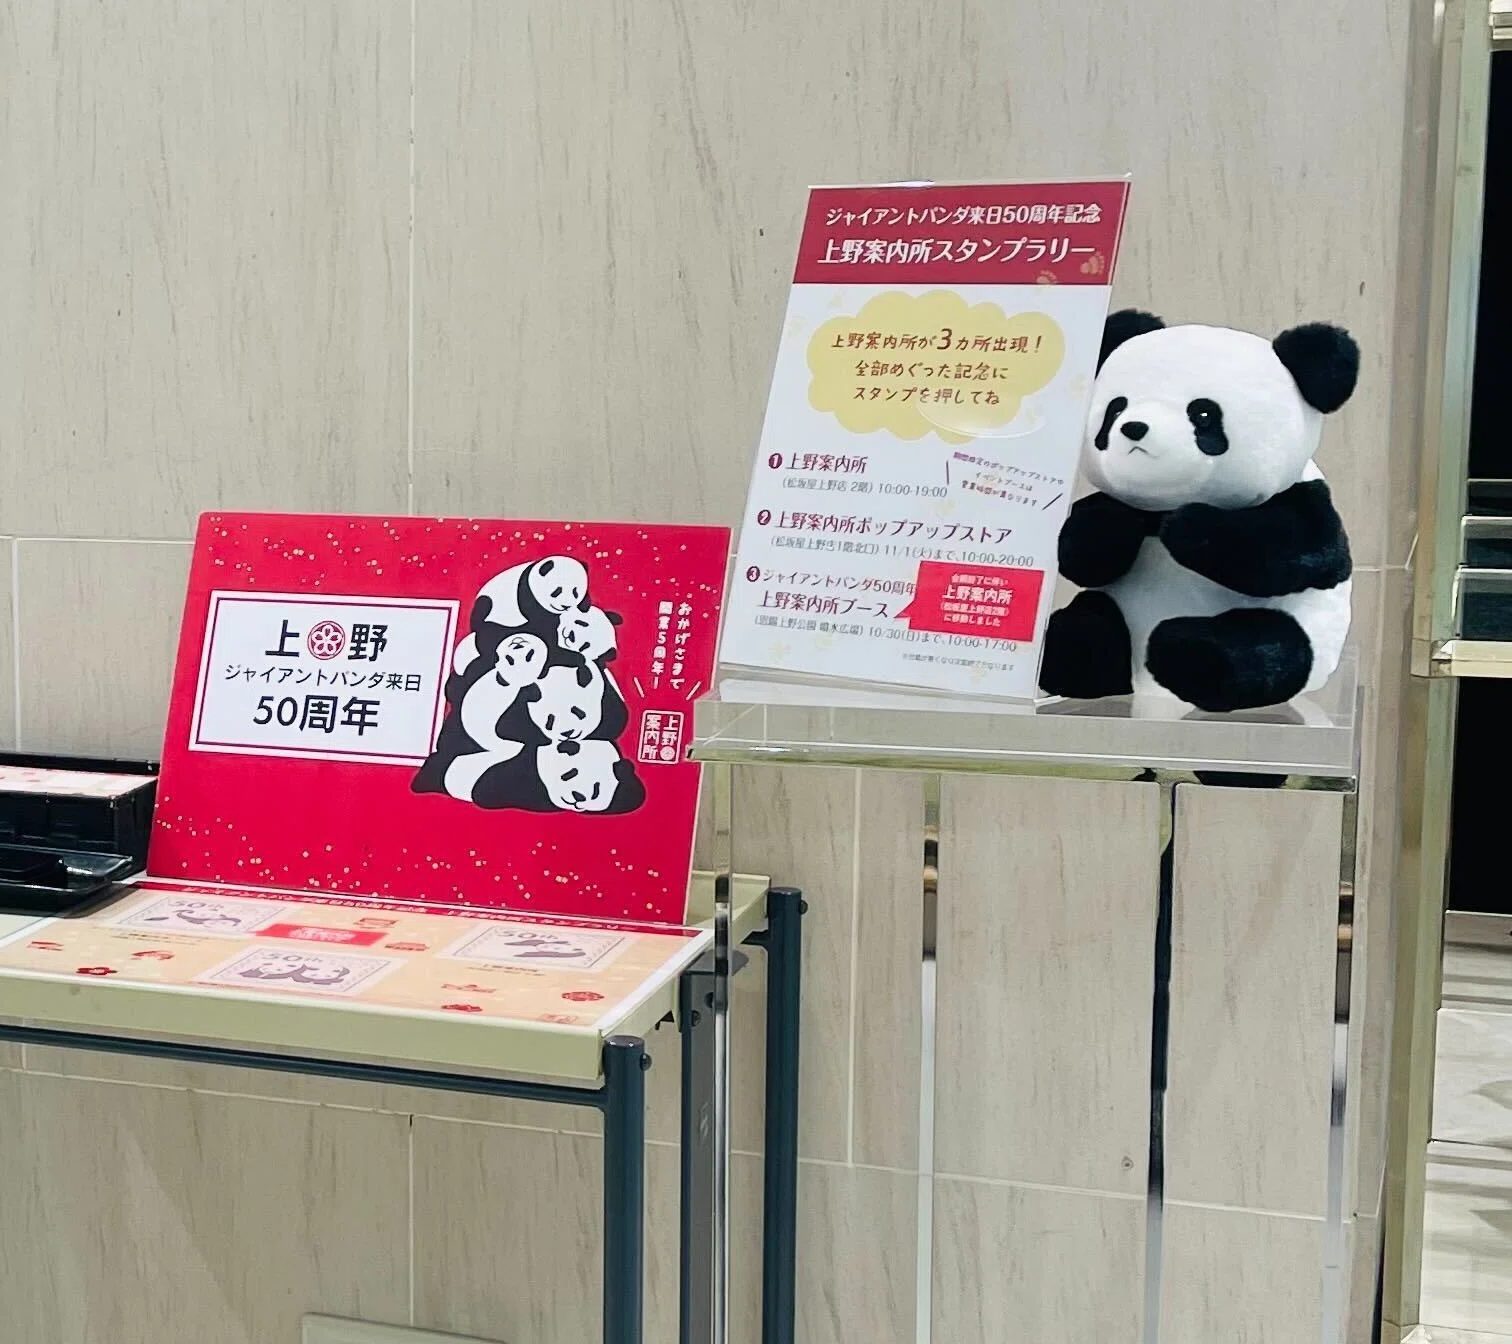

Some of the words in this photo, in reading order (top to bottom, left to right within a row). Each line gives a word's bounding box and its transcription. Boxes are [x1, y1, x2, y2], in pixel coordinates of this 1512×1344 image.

[826, 203, 1103, 227] ジャイアントパンダ来日50周年記念
[817, 237, 1096, 264] 上野案内所スタンプラリー
[854, 360, 1009, 381] 全部めぐった記念に
[852, 386, 1000, 405] スタンプを押してね
[785, 452, 868, 474] 上野案内所
[773, 510, 1013, 545] 上野案内所ポップアップストア
[759, 590, 889, 618] 上野案内所ブース
[942, 584, 1013, 604] 上野案内所
[669, 601, 693, 690] おかげさまで
[225, 664, 422, 692] ジャイアントパンダ来日
[253, 694, 381, 736] 50周年
